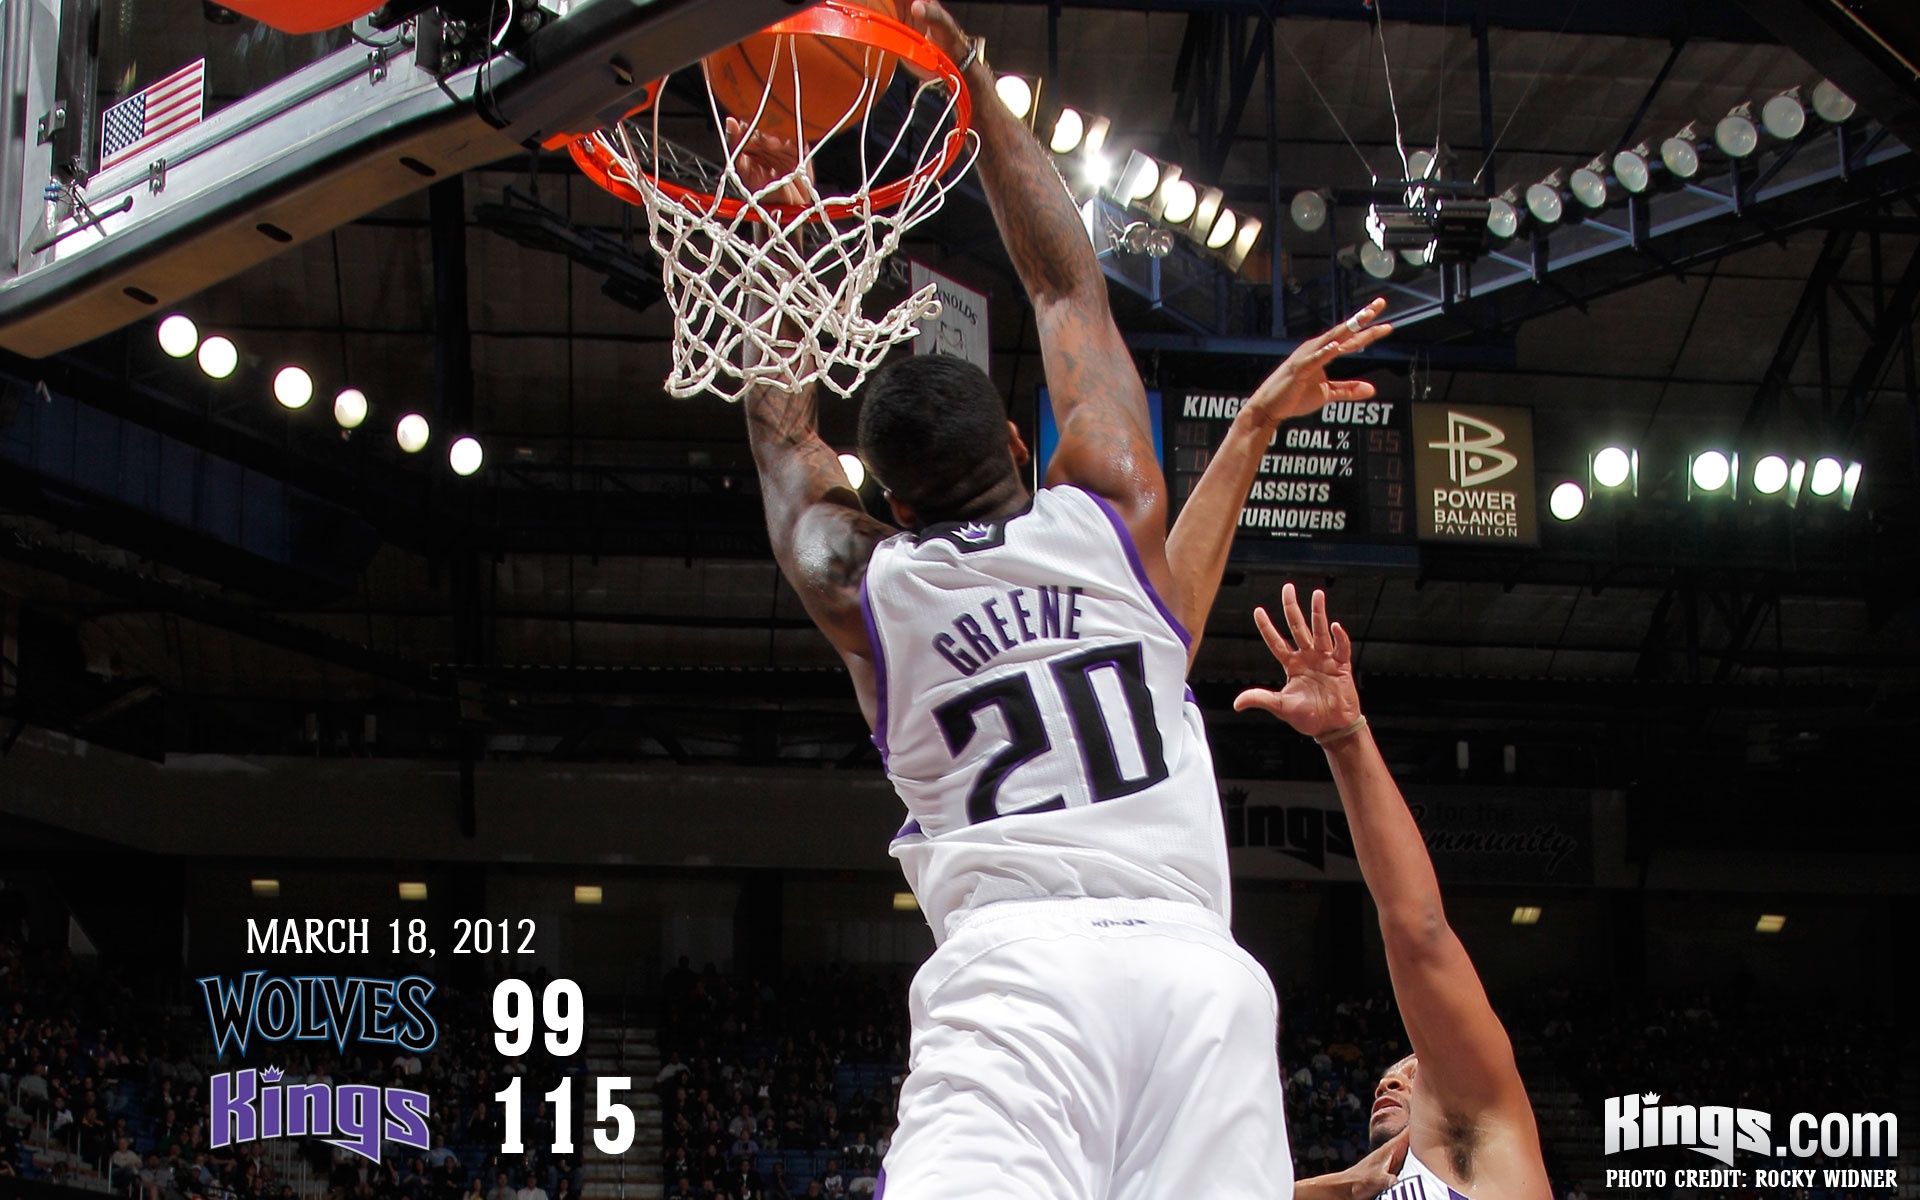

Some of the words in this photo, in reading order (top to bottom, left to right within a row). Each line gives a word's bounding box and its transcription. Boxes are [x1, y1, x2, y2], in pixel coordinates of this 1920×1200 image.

[1322, 401, 1394, 425] GUEST
[1286, 429, 1332, 449] GOAL
[1369, 430, 1400, 453] 55
[1249, 481, 1331, 503] ASSISTS
[1433, 489, 1516, 511] POWER
[1434, 509, 1517, 527] BALANCE
[1435, 524, 1518, 538] PAVILION
[931, 584, 1084, 677] GREENE
[930, 640, 1169, 826] 20
[1226, 786, 1357, 872] ings
